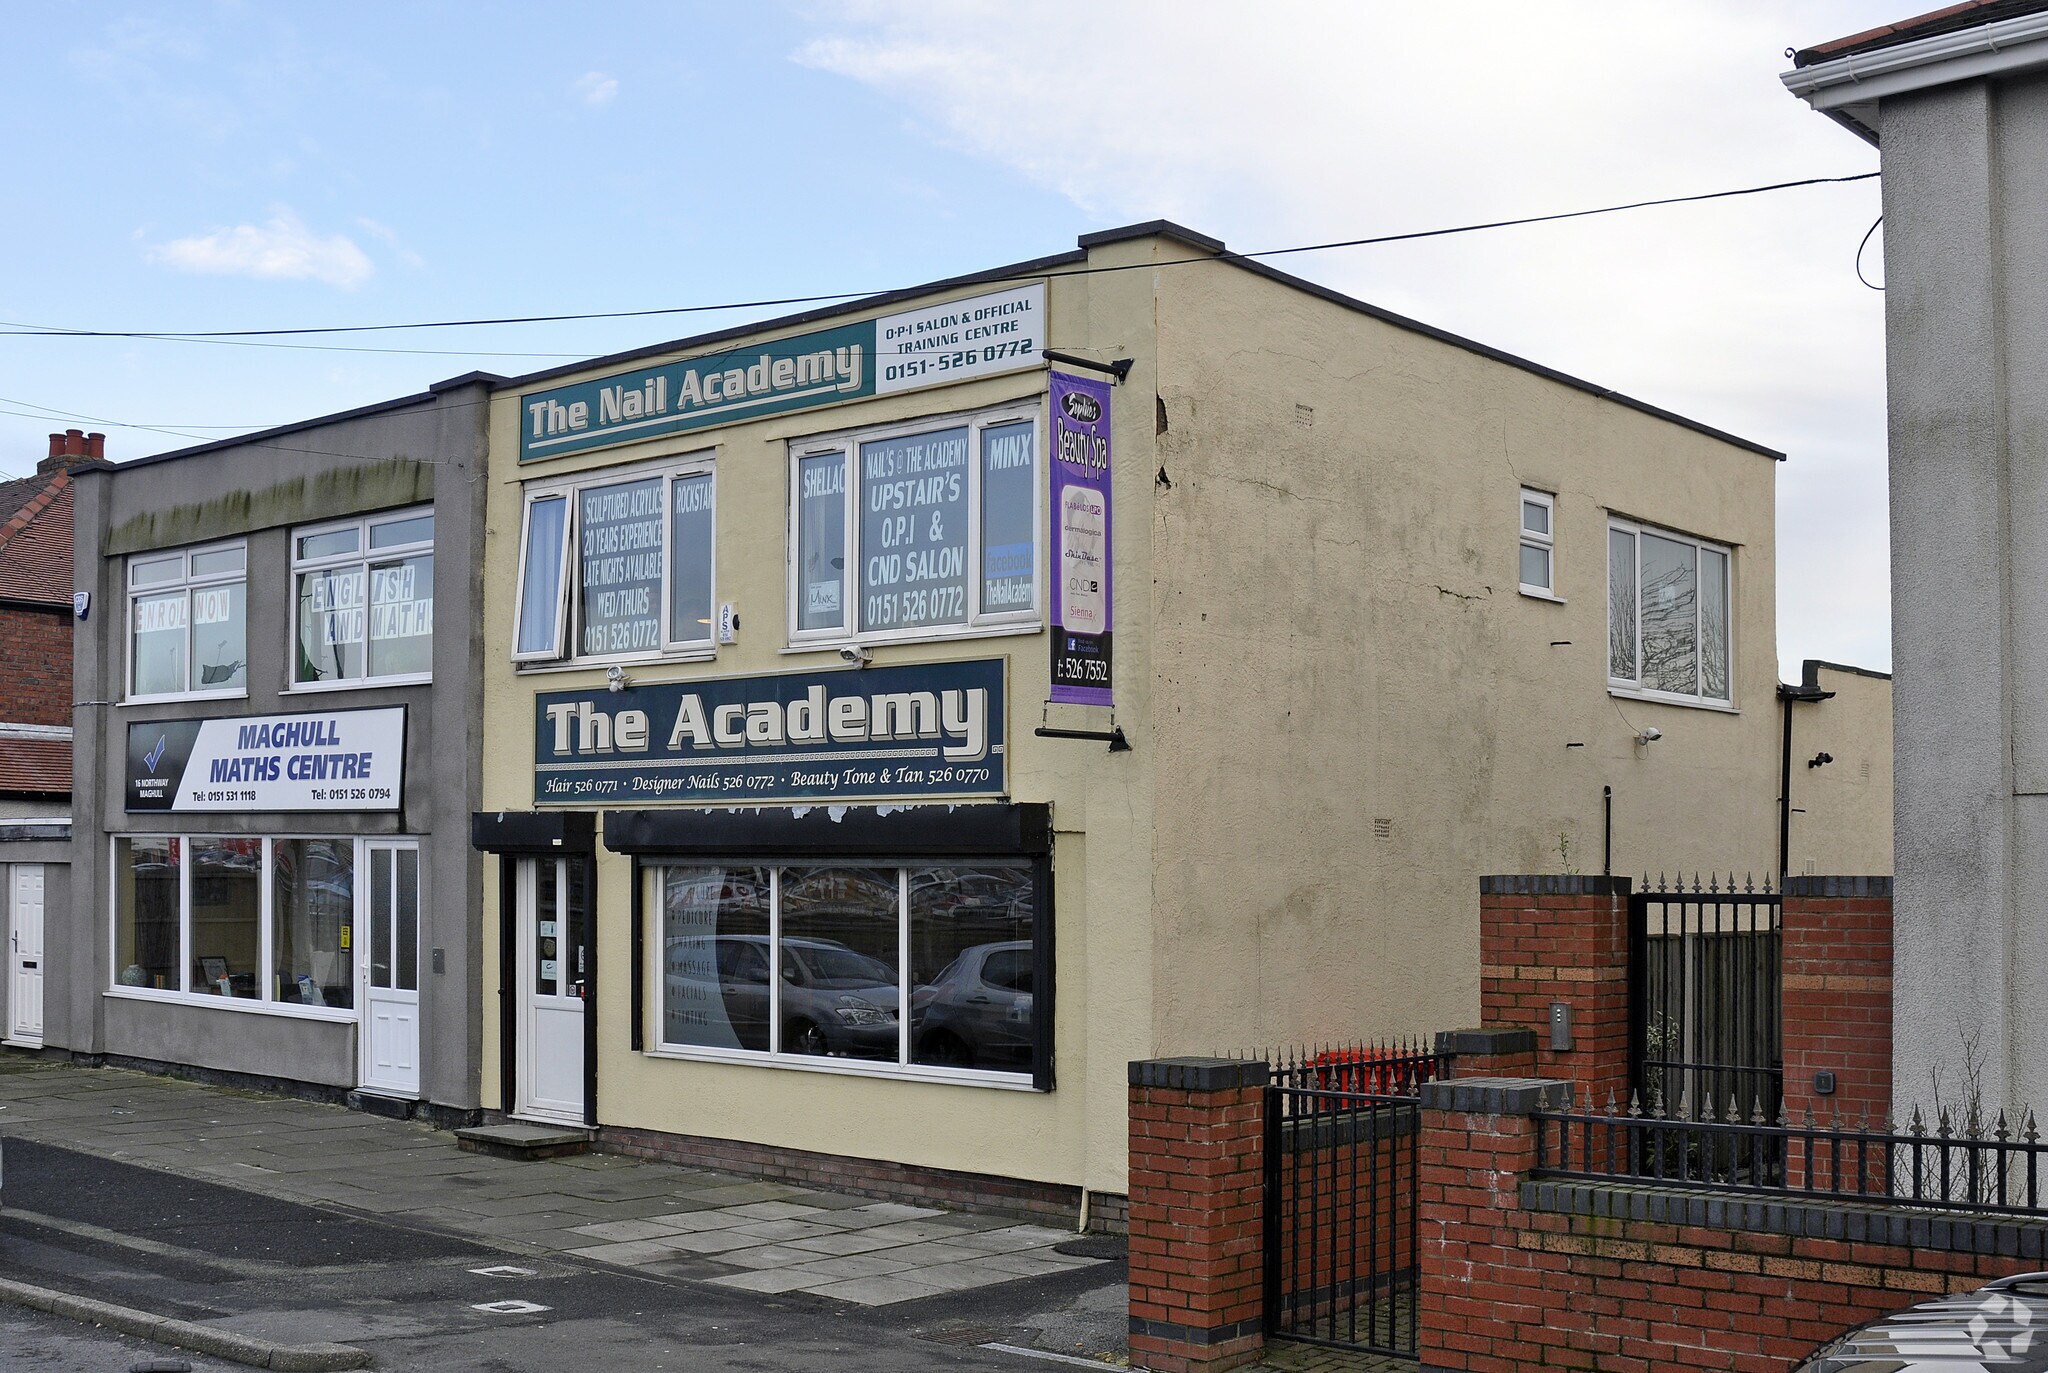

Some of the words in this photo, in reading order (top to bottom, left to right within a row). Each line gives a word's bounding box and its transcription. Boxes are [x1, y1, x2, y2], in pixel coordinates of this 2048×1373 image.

[917, 314, 958, 333] SALON
[961, 312, 971, 324] &
[974, 299, 1032, 321] OFFICIAL
[897, 332, 959, 354] TRAINING
[965, 320, 1019, 341] CENTRE
[983, 338, 1033, 362] 0772
[529, 399, 588, 437] The
[600, 376, 667, 425] Nail
[677, 344, 863, 408] Academy
[866, 447, 894, 480] NAIL'S
[906, 444, 922, 474] THE
[924, 438, 968, 471] ACADEMY
[990, 433, 1032, 470] MINX
[1057, 416, 1090, 479] Beauty
[1091, 424, 1107, 480] Spa
[804, 464, 845, 499] SHELLAC
[871, 472, 961, 512] UPSTAIR'S
[585, 492, 629, 525] SCULPTURED
[630, 486, 663, 518] ACRYLICS
[584, 529, 594, 556] 20
[596, 526, 618, 555] YEARS
[620, 519, 662, 551] EXPERIENCE
[929, 510, 943, 542] &
[583, 560, 600, 588] LATE
[625, 552, 662, 582] AVAILABLE
[868, 553, 899, 587] CND
[905, 546, 964, 583] SALON
[314, 570, 413, 609] ENGLISH
[1070, 577, 1091, 592] CND
[136, 600, 186, 631] ENROL
[195, 591, 229, 620] NOW
[597, 586, 650, 618] WED/THURS
[867, 593, 898, 626] 0151
[902, 590, 927, 622] 526
[930, 585, 964, 619] 0772
[326, 611, 362, 642] AND
[372, 601, 433, 637] MATH
[584, 625, 608, 653] 0151
[611, 621, 630, 650] 526
[632, 619, 658, 648] 0772
[1066, 657, 1083, 679] 526
[1085, 659, 1108, 681] 7552
[237, 720, 340, 750] MAGHULL
[546, 699, 649, 757] The
[667, 684, 988, 763] Academy
[141, 778, 169, 788] NORTHWAY
[210, 756, 281, 783] MATHS
[287, 752, 373, 781] CENTRE
[545, 777, 571, 793] Hair
[575, 778, 592, 794] 526
[595, 779, 618, 794] 0771
[632, 776, 685, 795] Designer
[687, 773, 719, 790] Nails
[723, 774, 744, 791] 526
[747, 775, 775, 790] 0772
[791, 771, 839, 790] Beauty
[843, 768, 876, 785] Tone
[880, 768, 891, 784] &
[895, 766, 924, 783] Tan
[927, 767, 953, 785] 526
[956, 768, 990, 784] 0770
[140, 789, 164, 798] MAGHULL
[193, 791, 206, 801] Tel:
[208, 791, 224, 801] 0151
[226, 791, 238, 801] 531
[240, 790, 256, 801] 1118
[312, 789, 326, 800] Tel:
[329, 788, 348, 800] 0151
[350, 788, 366, 800] 526
[368, 787, 391, 800] 0794
[677, 910, 713, 926] PEDICURE
[677, 960, 710, 976] MASSAGE
[677, 985, 707, 1001] FACIALS
